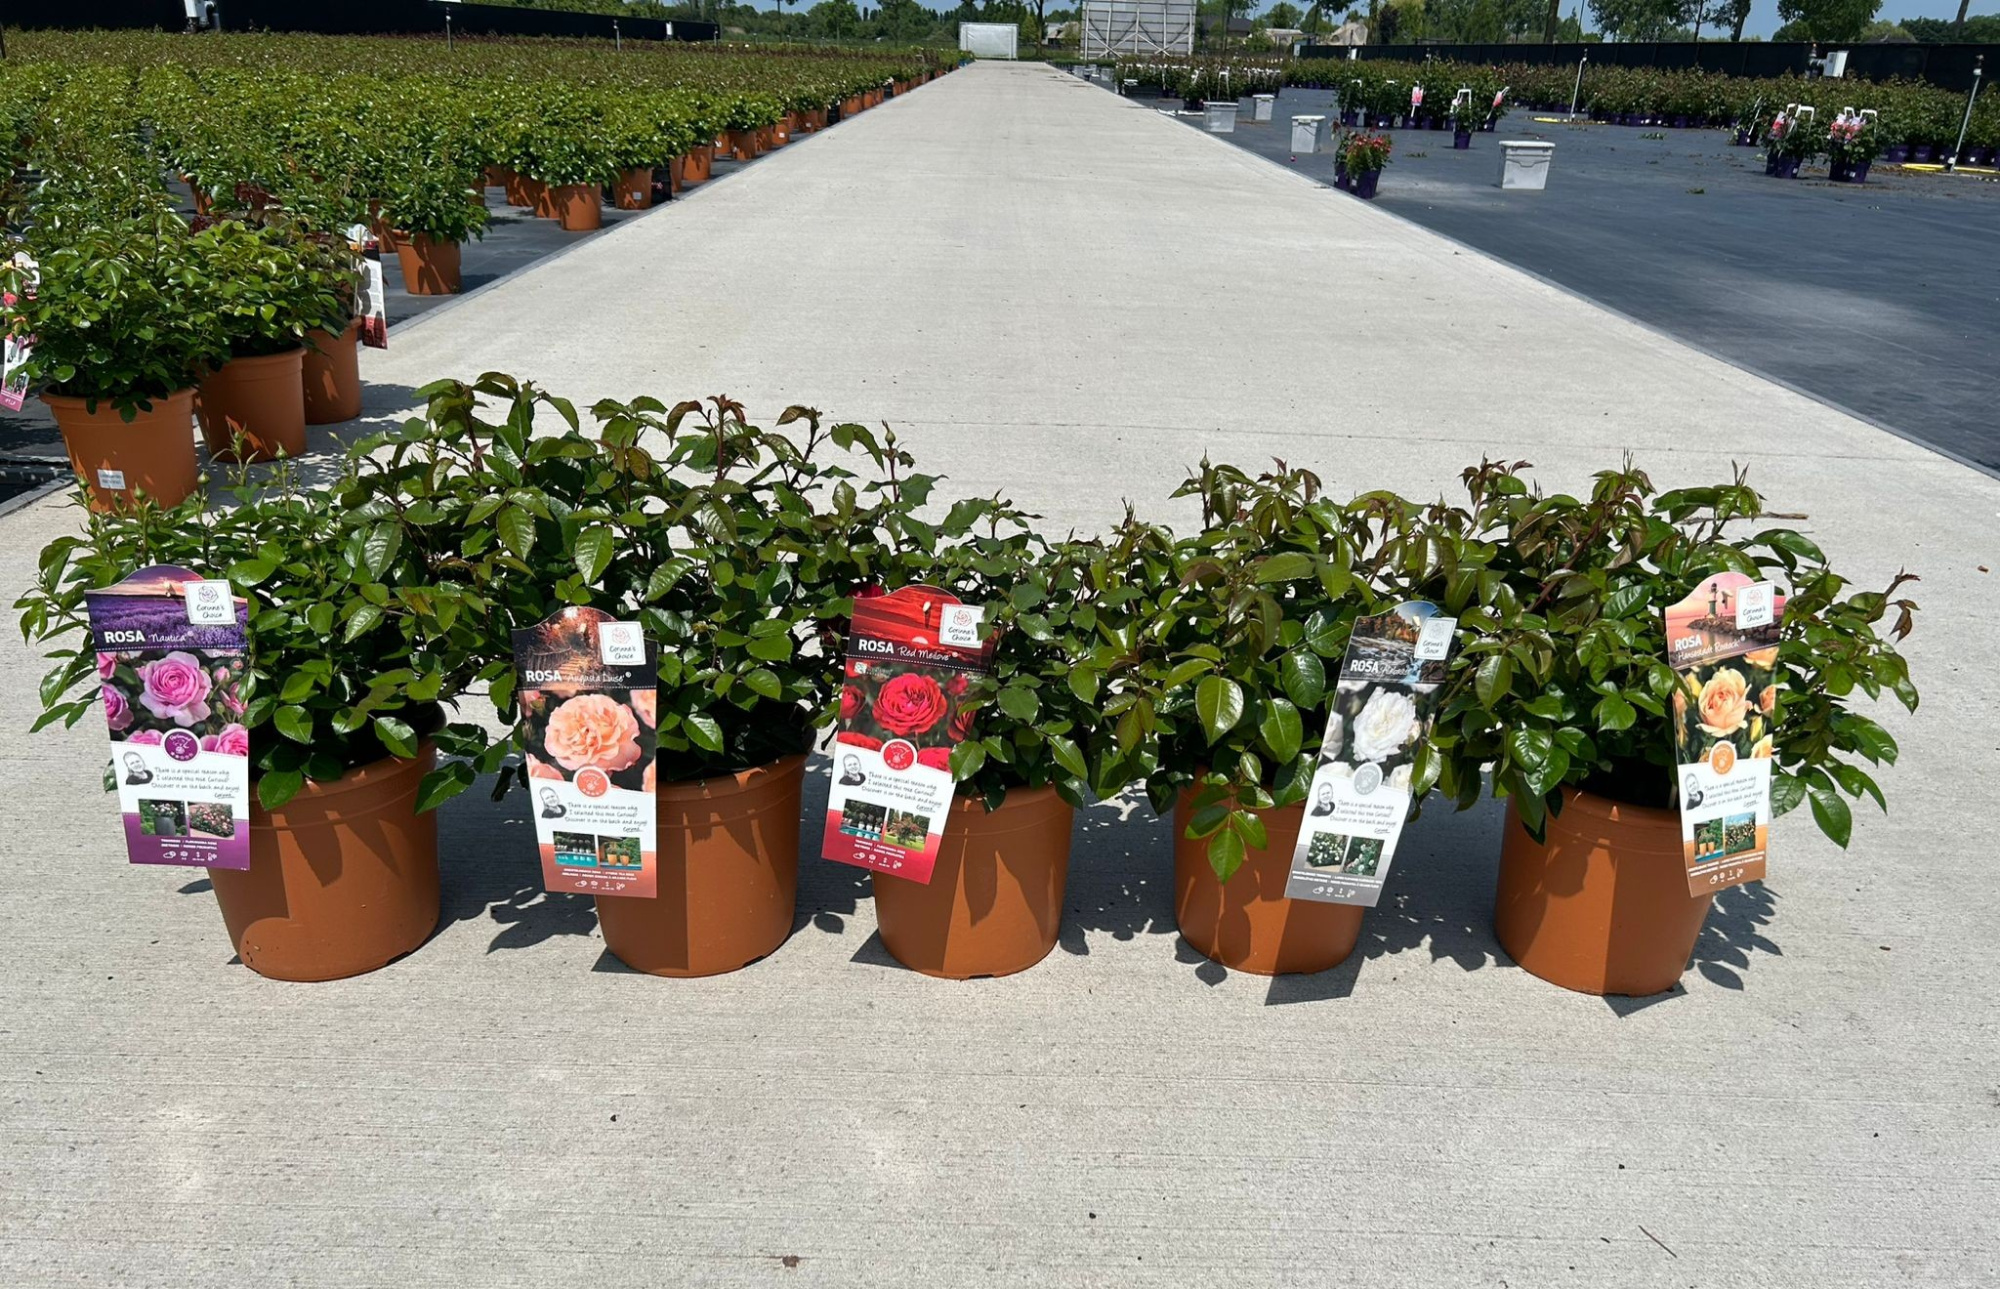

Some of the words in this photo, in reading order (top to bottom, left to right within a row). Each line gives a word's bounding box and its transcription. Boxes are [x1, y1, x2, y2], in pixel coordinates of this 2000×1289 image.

[104, 630, 145, 643] ROSA
[1674, 634, 1702, 651] ROSA
[858, 639, 894, 654] ROSA
[1350, 660, 1378, 673] ROSA
[525, 670, 562, 681] ROSA
